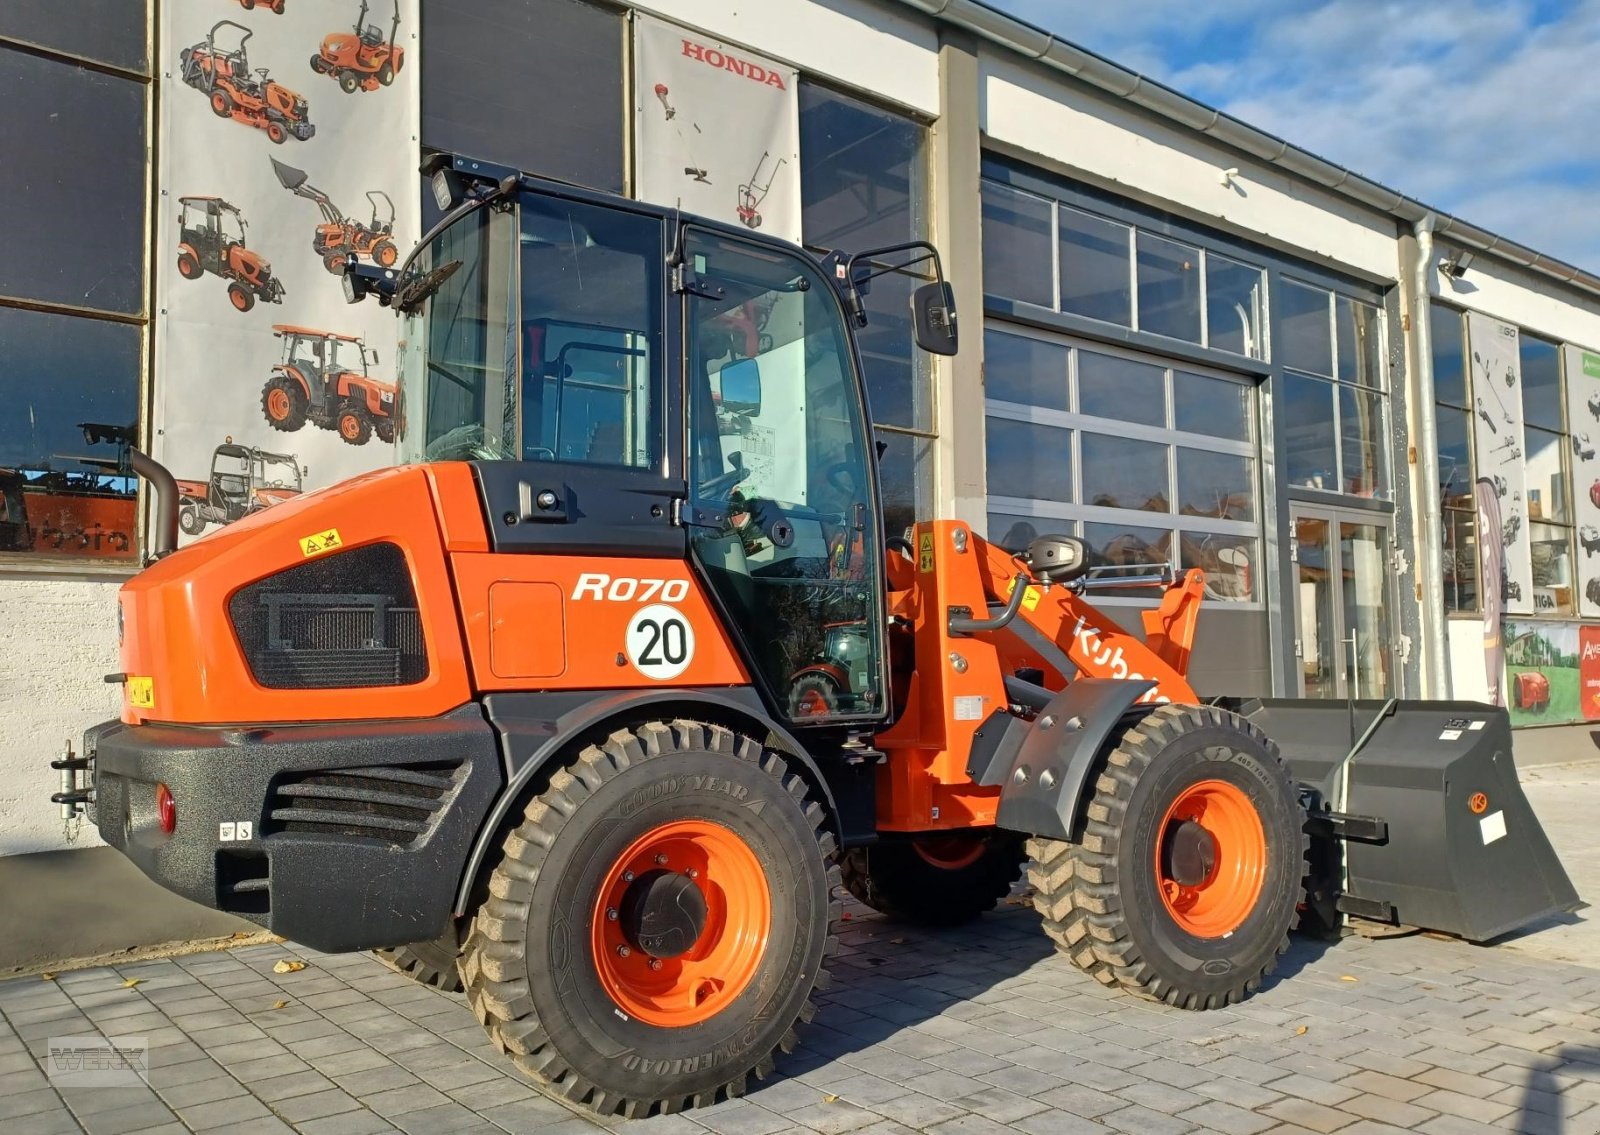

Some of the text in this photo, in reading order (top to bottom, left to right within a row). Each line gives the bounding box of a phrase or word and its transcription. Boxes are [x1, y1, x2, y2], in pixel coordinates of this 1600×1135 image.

[682, 39, 786, 91] HONDA
[570, 573, 690, 602] R070
[636, 618, 687, 665] 20
